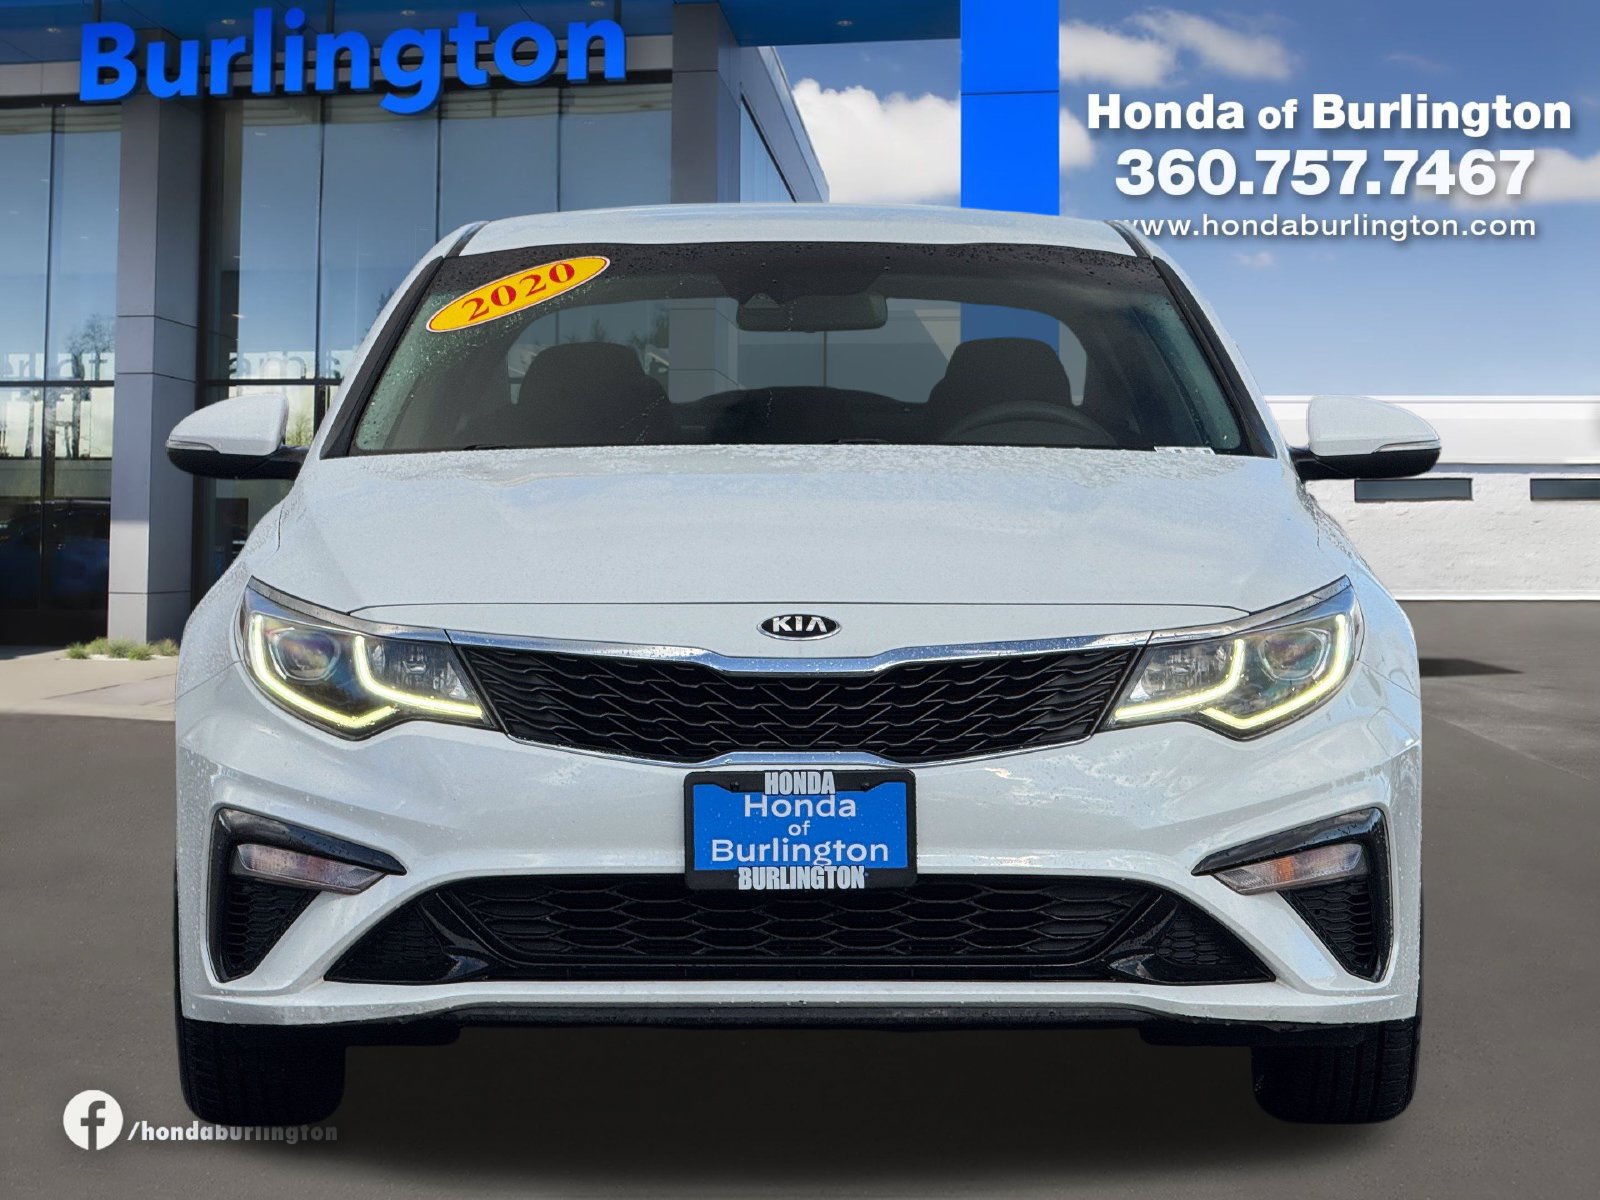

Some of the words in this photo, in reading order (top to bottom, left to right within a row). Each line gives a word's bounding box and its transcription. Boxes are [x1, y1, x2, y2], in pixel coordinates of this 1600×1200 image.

[79, 7, 627, 115] Burlington
[461, 263, 575, 321] 2020
[772, 616, 828, 633] KIA
[764, 771, 836, 795] HONDA
[744, 795, 857, 818] Honda
[788, 820, 811, 836] of
[711, 837, 889, 866] Burlington
[738, 865, 865, 891] BURLINGTON
